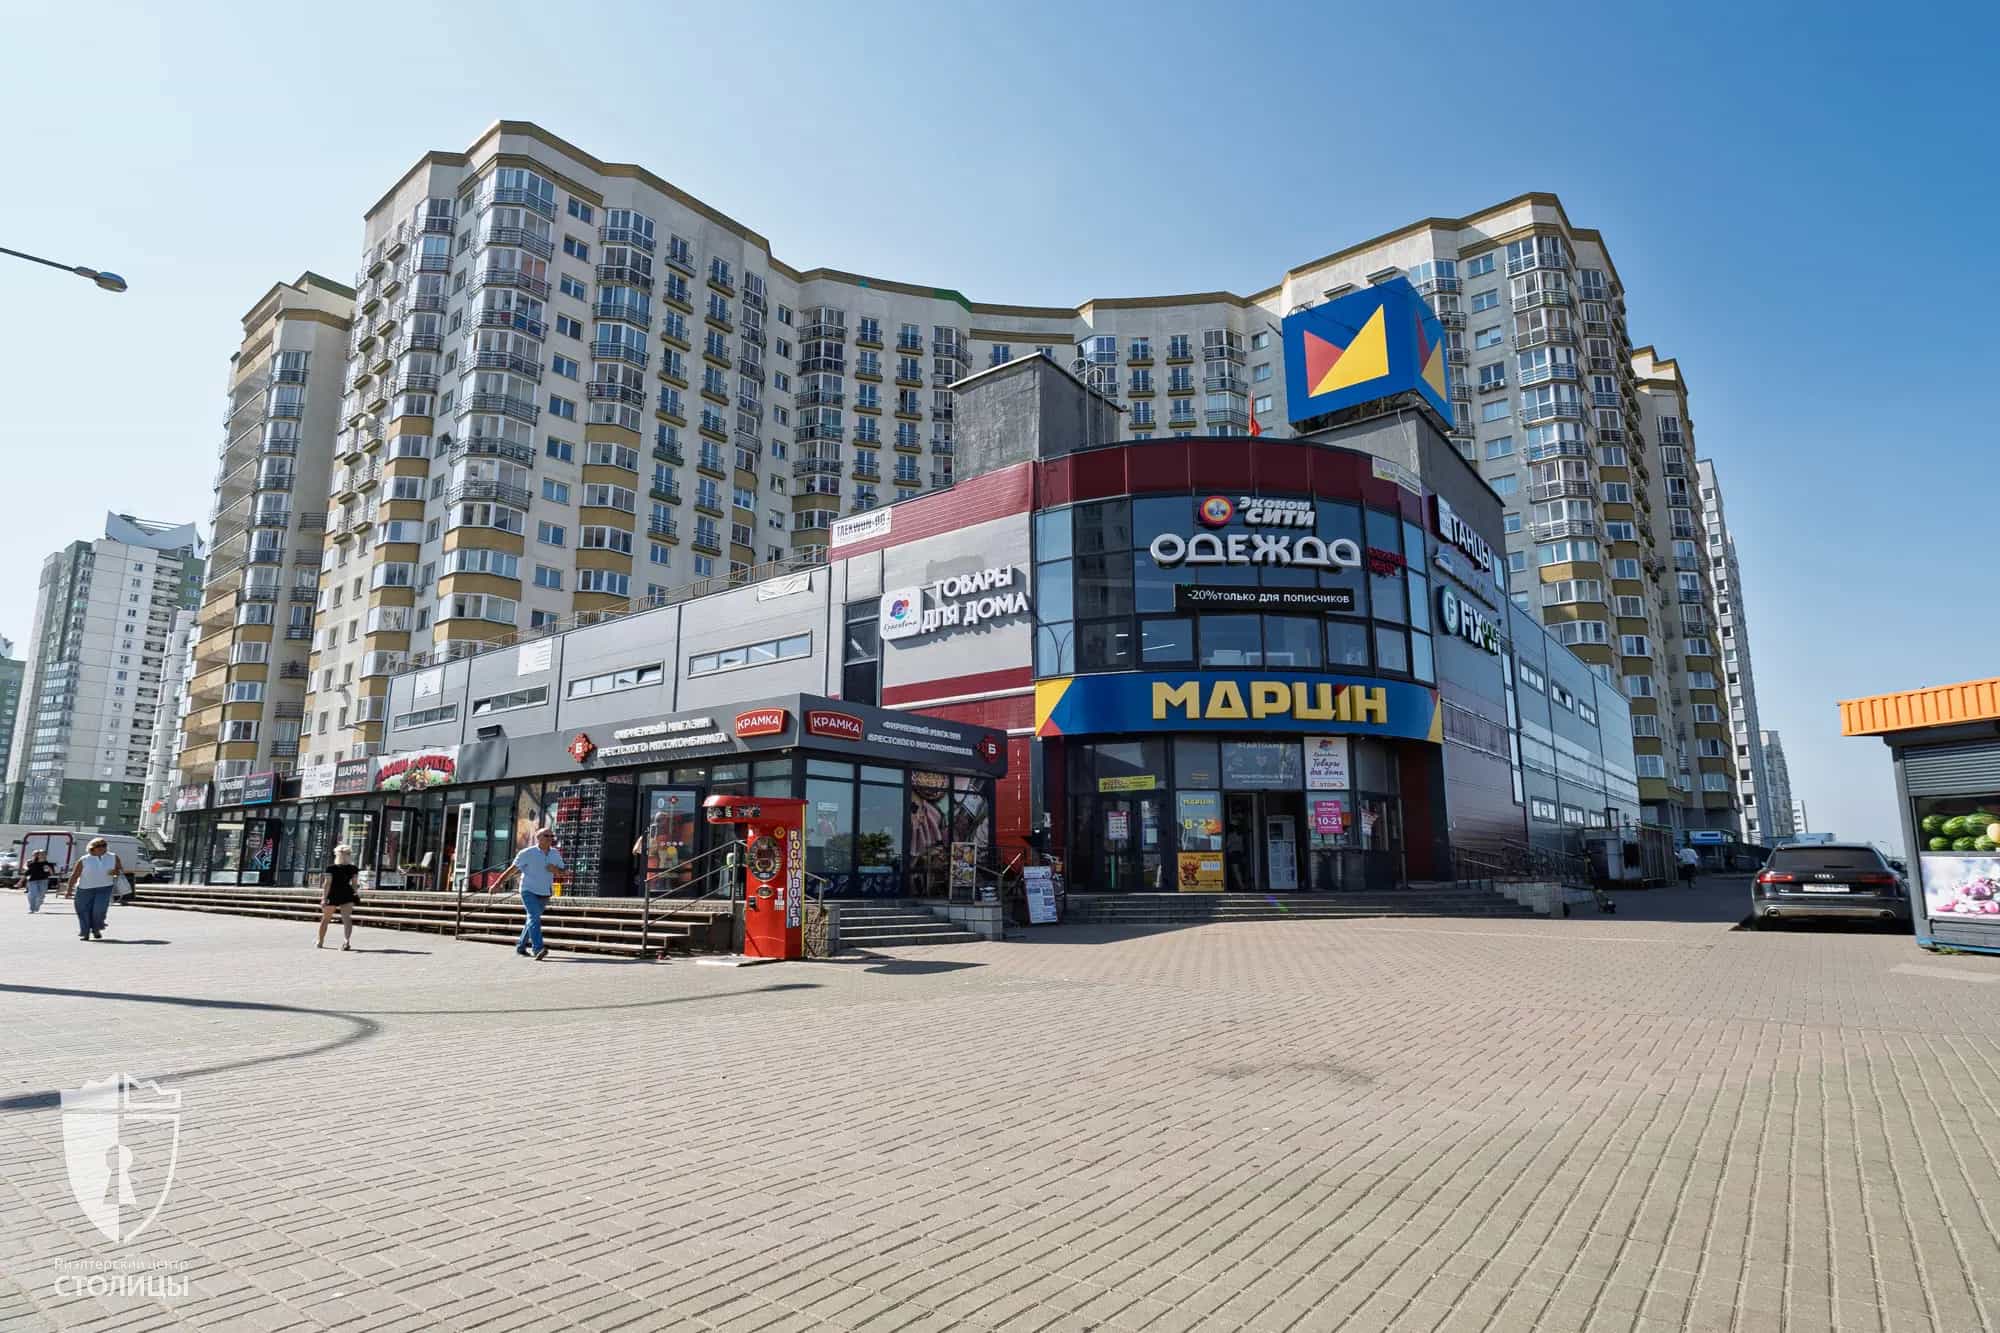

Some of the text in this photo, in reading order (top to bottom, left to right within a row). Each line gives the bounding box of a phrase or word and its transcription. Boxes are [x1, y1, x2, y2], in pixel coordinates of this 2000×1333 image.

[1245, 508, 1316, 527] СИТИ
[1150, 533, 1362, 567] ОДЕЖДА
[1450, 513, 1492, 571] ТАНЦЫ
[932, 564, 1014, 599] ТОВАРЫ
[1259, 592, 1280, 603] для
[921, 591, 1030, 634] ДЛЯ ДОМА
[737, 713, 780, 731] КРАМКА
[813, 717, 860, 734] КРАМКА
[338, 763, 367, 777] ШАУРМА
[1317, 816, 1342, 826] 10-21
[789, 830, 801, 927] ROCKY BOXER
